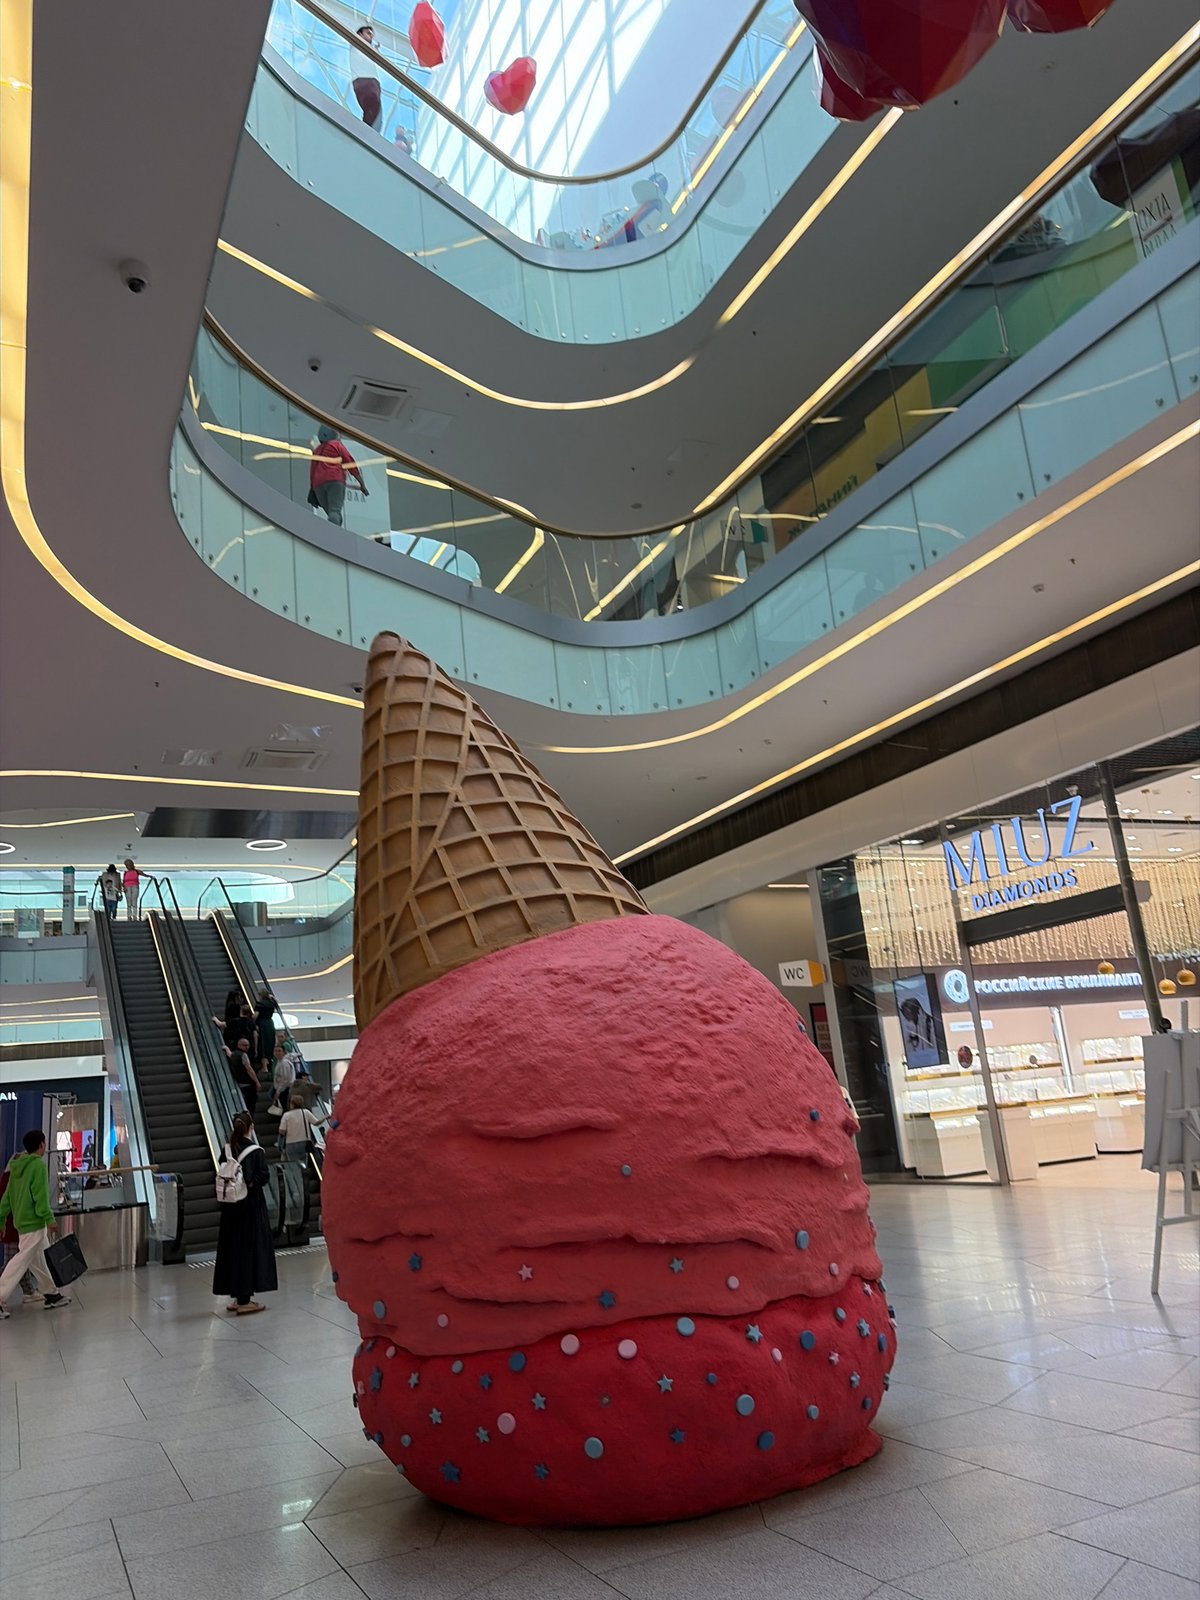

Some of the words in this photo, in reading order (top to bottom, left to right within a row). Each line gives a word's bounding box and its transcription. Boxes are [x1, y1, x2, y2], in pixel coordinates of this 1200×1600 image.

[942, 795, 1095, 891] MIUZ
[971, 868, 1078, 912] DIAMONDS
[783, 967, 804, 979] WC
[973, 975, 1064, 993] РОССИЙСКИЕ
